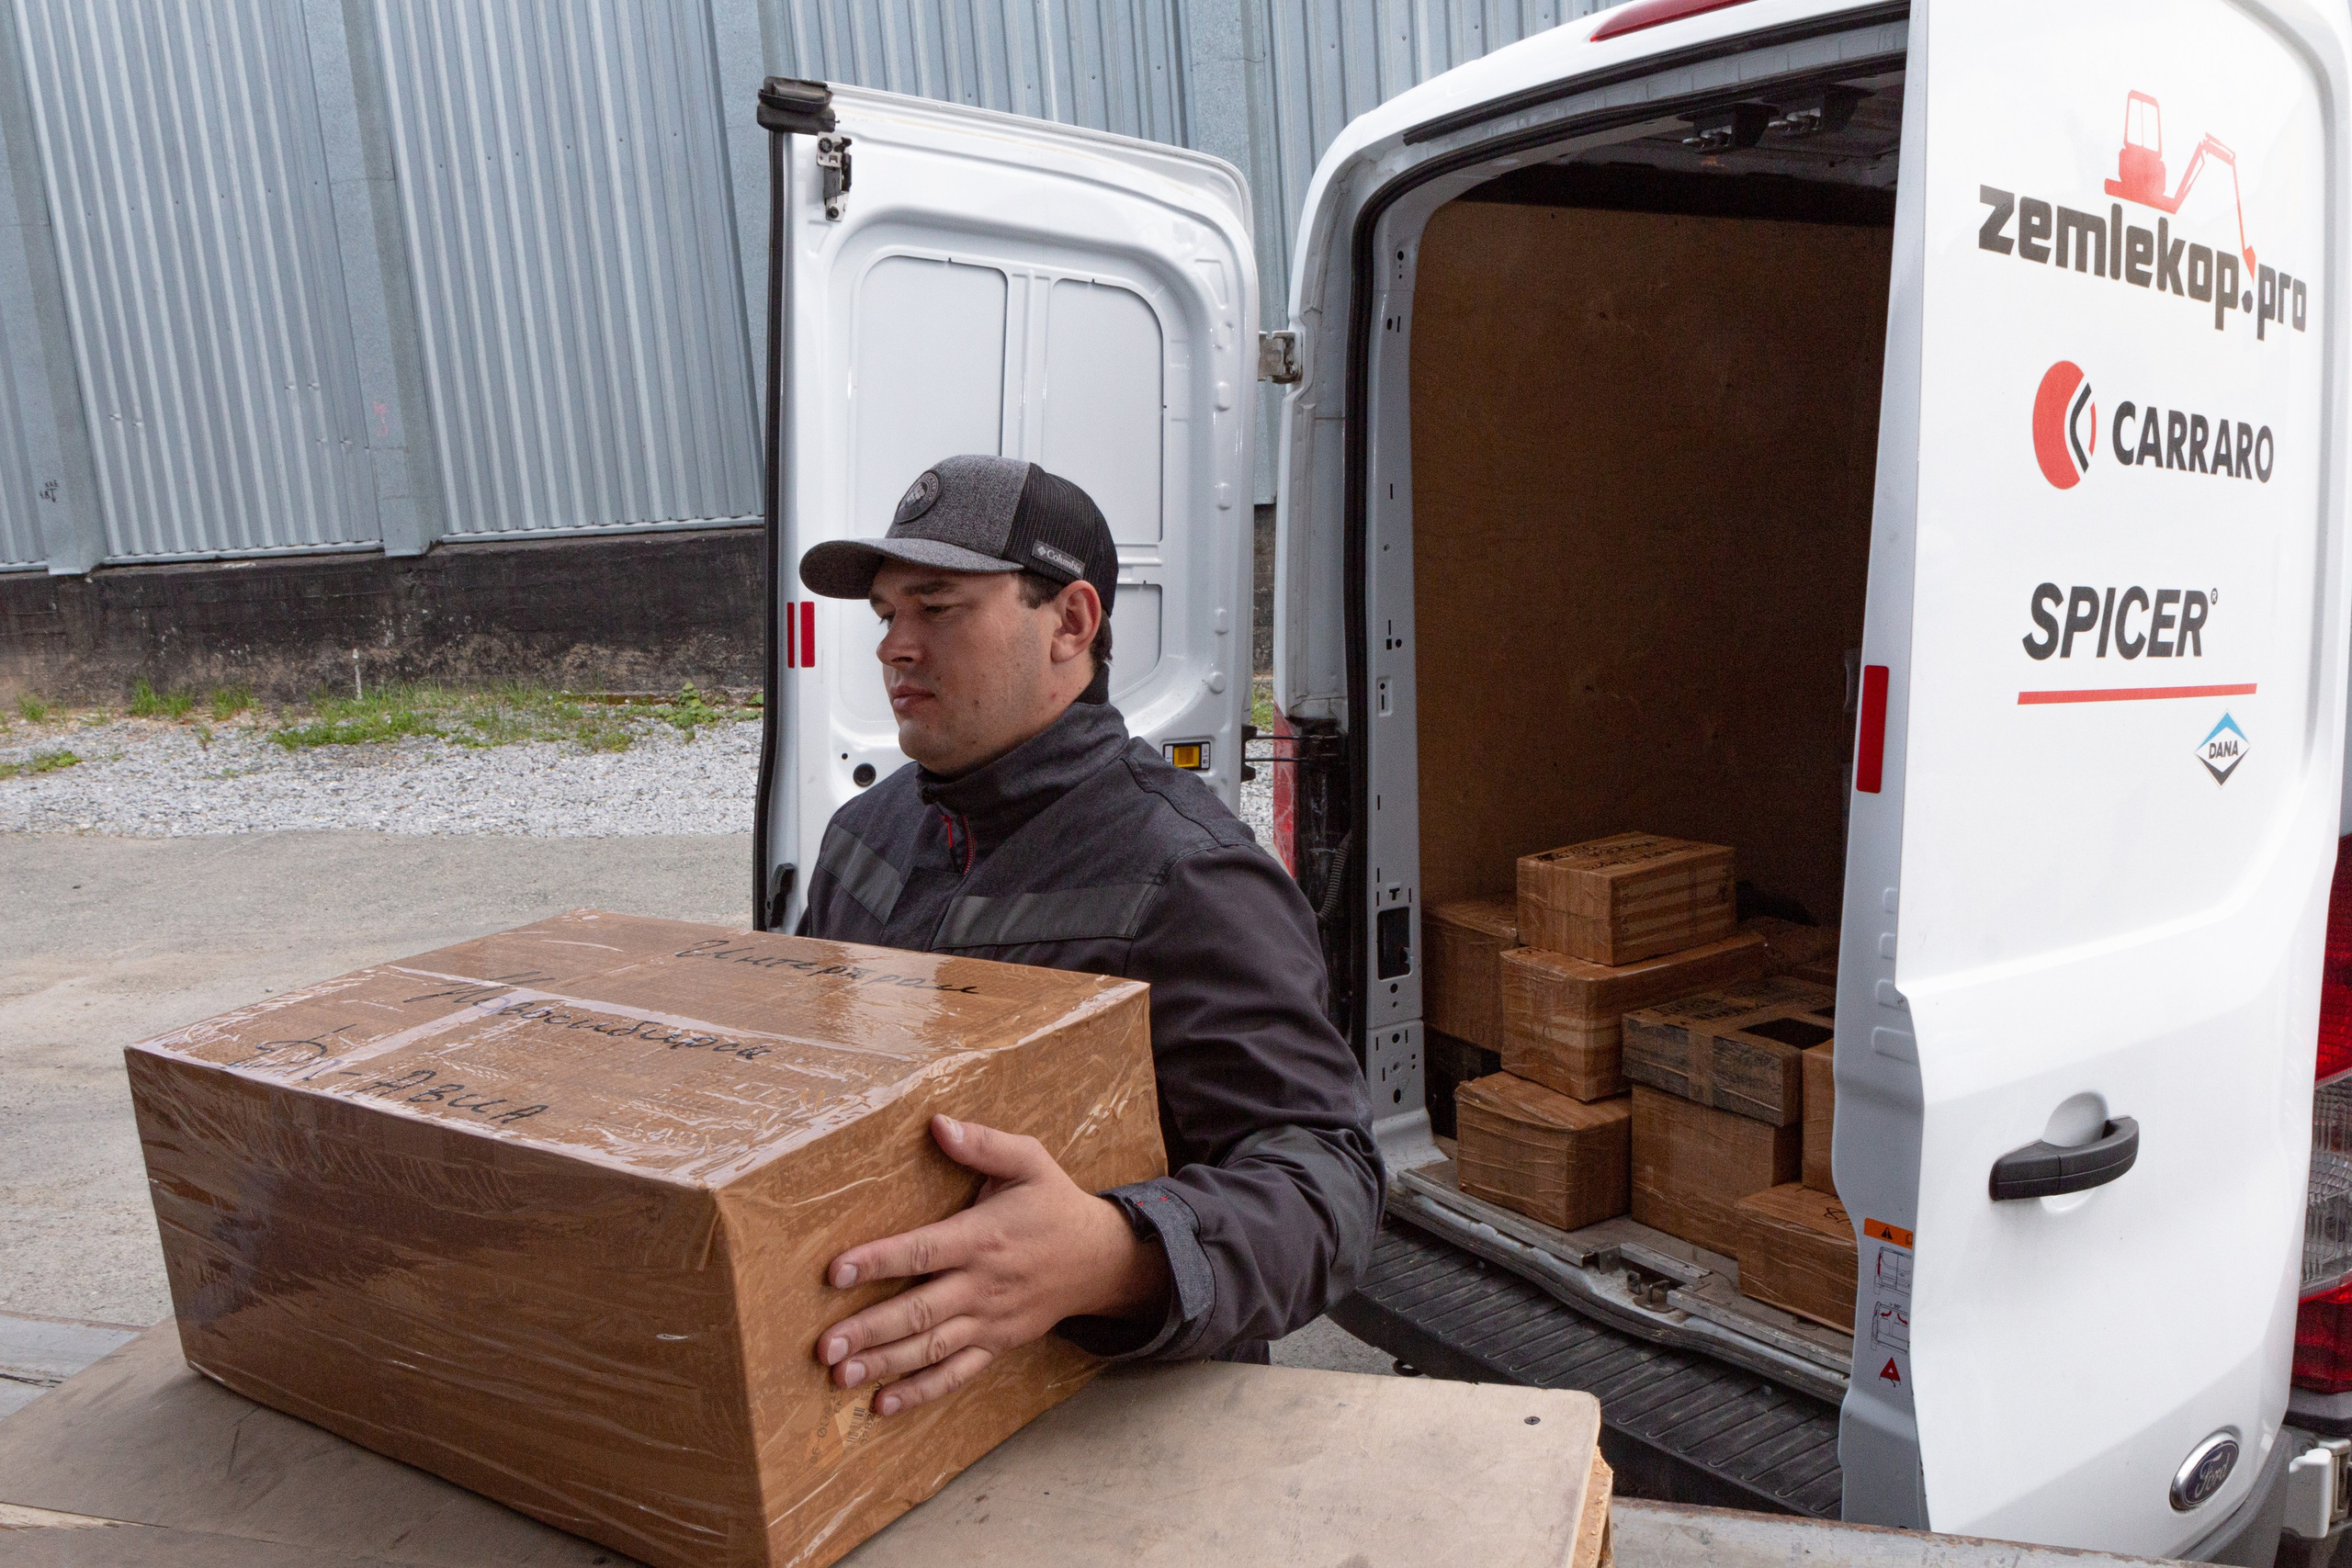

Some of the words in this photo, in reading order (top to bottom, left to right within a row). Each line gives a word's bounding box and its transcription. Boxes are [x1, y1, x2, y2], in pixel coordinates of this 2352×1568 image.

[1978, 184, 2307, 342] zemlekop.pro
[2112, 400, 2275, 483] CARRARO
[1046, 549, 1081, 574] Columbia
[2208, 739, 2240, 760] DANA
[2194, 1451, 2231, 1498] Ford
